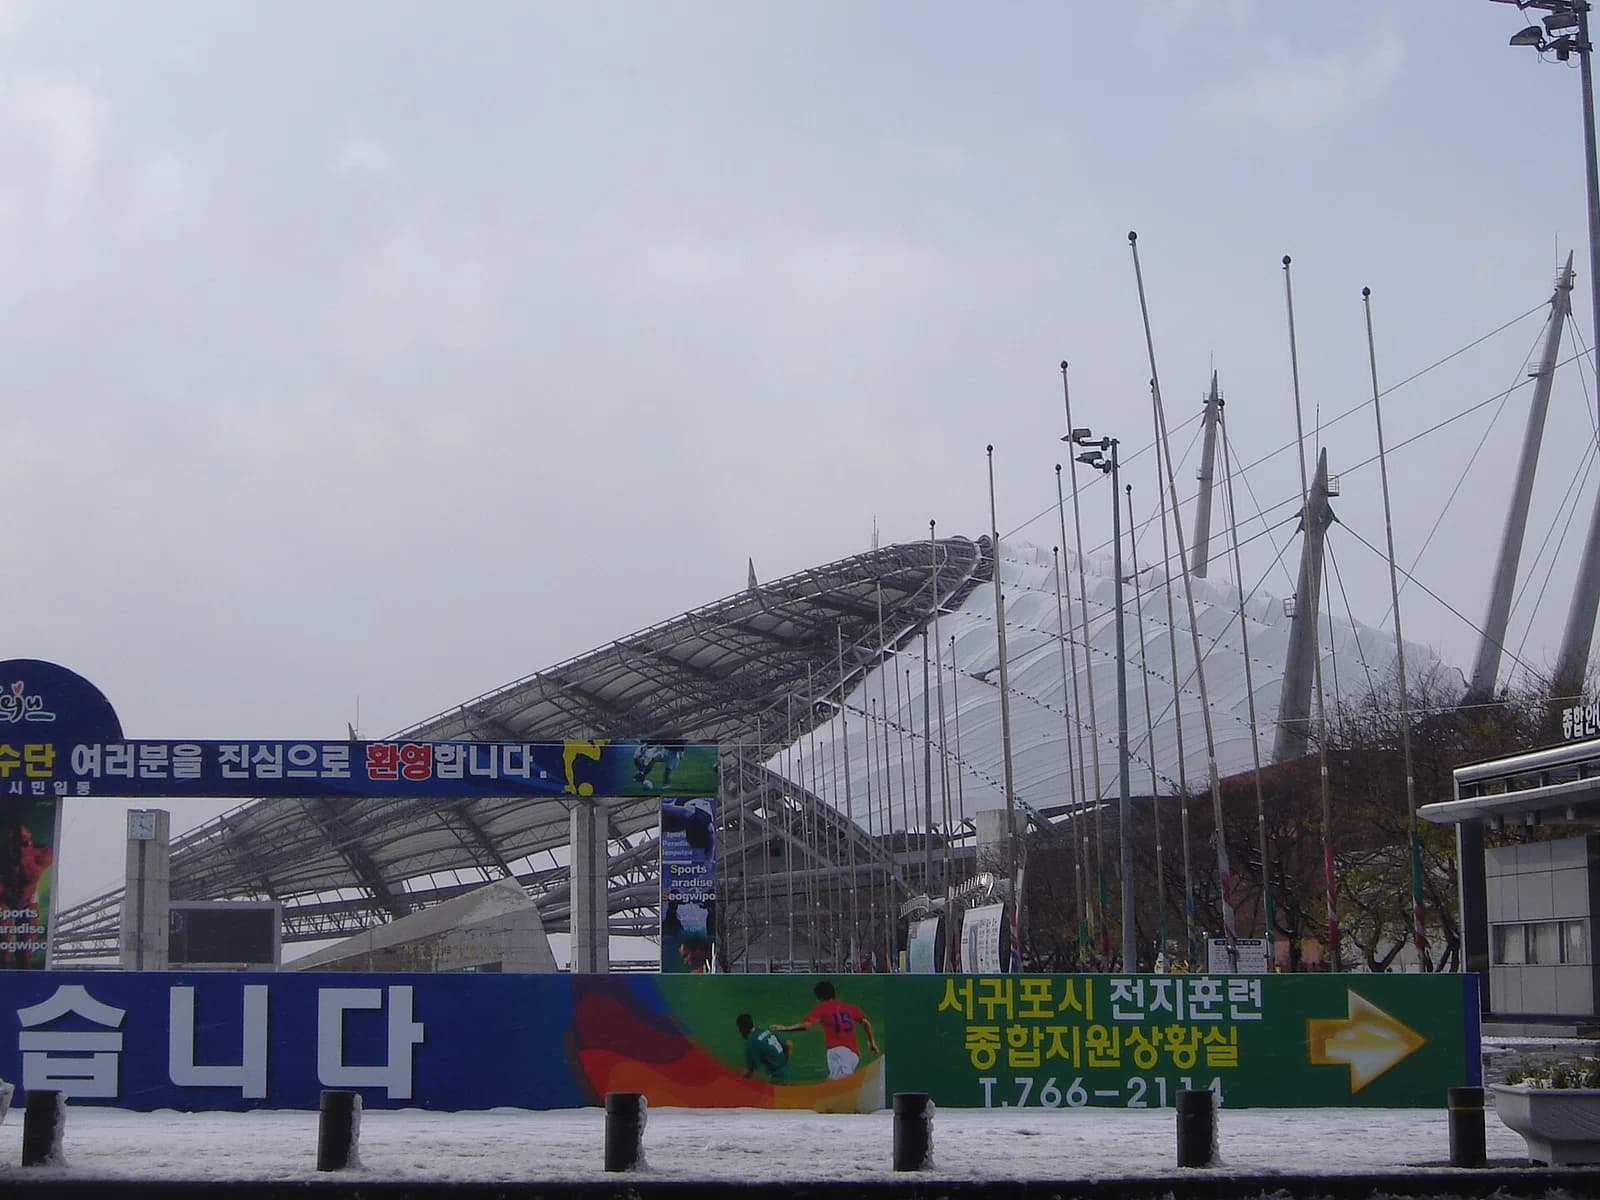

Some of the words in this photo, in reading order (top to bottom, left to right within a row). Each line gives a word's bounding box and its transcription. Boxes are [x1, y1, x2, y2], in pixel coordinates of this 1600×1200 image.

[71, 743, 202, 779] 여러분을
[217, 743, 352, 780] 진심으로
[365, 743, 548, 780] 환영합니다.
[670, 864, 707, 876] Sports
[662, 891, 716, 903] Seogwipo
[938, 978, 1094, 1021] 서귀포시
[1109, 977, 1263, 1021] 전지훈련
[832, 1011, 854, 1034] 15
[17, 984, 425, 1099] 습니다
[965, 1024, 1239, 1071] 종합지원상황실
